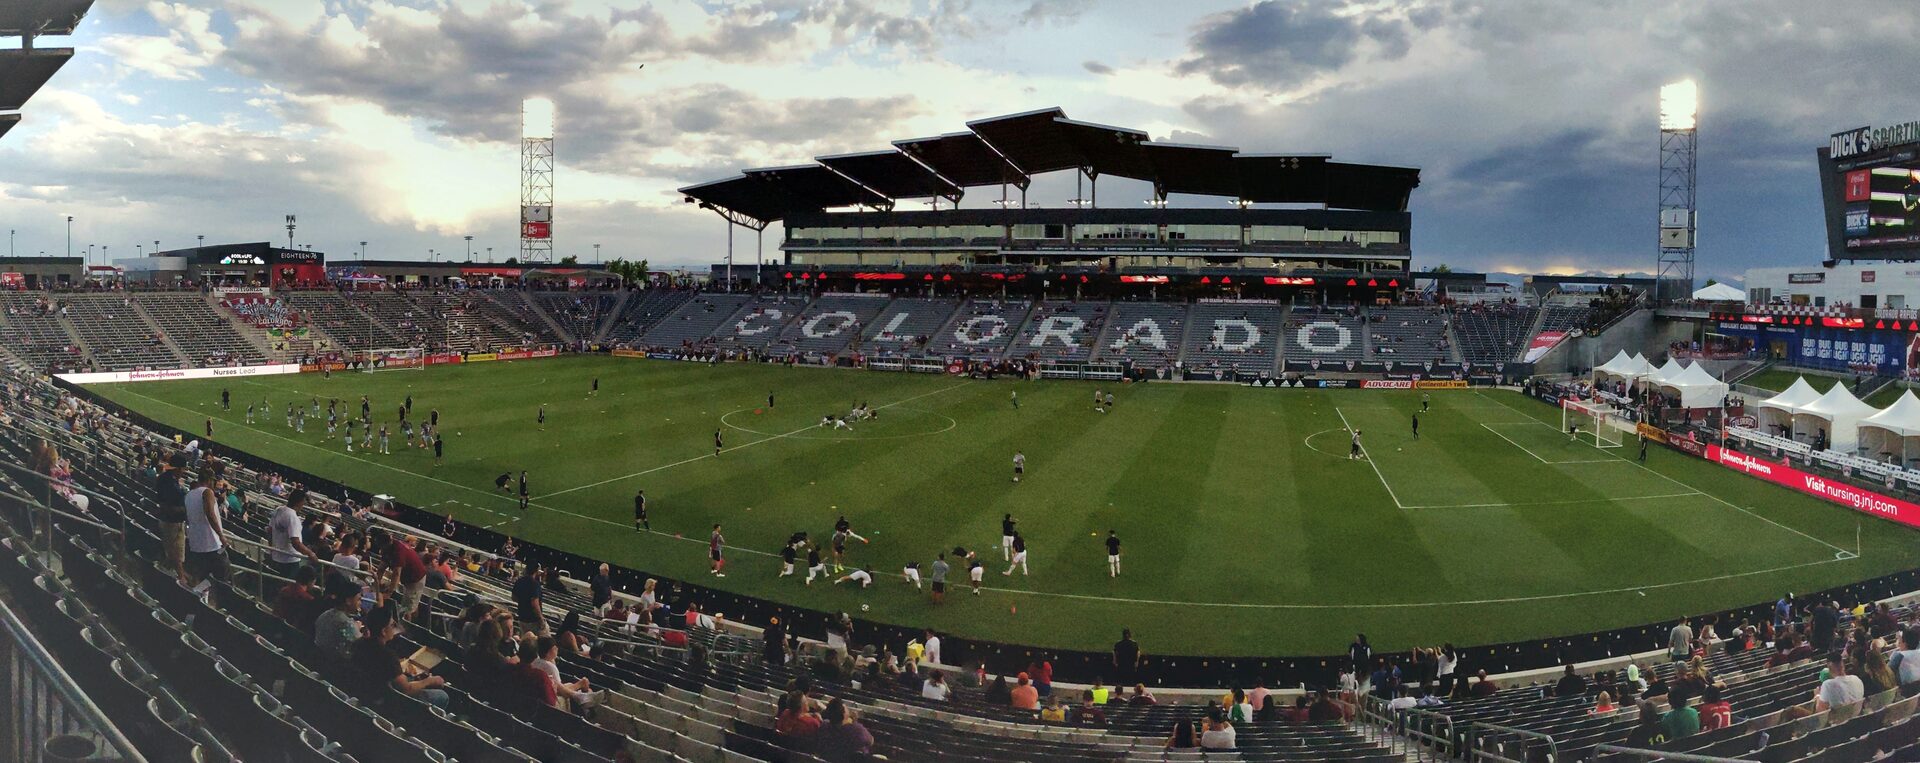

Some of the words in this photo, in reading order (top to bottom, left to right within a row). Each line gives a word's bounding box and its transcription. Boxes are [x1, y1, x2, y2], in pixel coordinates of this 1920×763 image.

[1830, 129, 1870, 159] DICK'S
[735, 308, 1352, 352] COLORADO
[1803, 338, 1815, 348] BUD
[1818, 339, 1832, 349] BUD
[1835, 340, 1848, 351] BUD
[1851, 342, 1866, 353] BUD
[1869, 343, 1885, 354] BUD
[213, 368, 238, 376] Nurses
[240, 367, 256, 375] Lead
[1364, 380, 1411, 388] ADVOCARE
[1415, 380, 1448, 388] Continental
[1805, 475, 1826, 494] Visit
[1826, 484, 1898, 516] nursing.jnj.com
